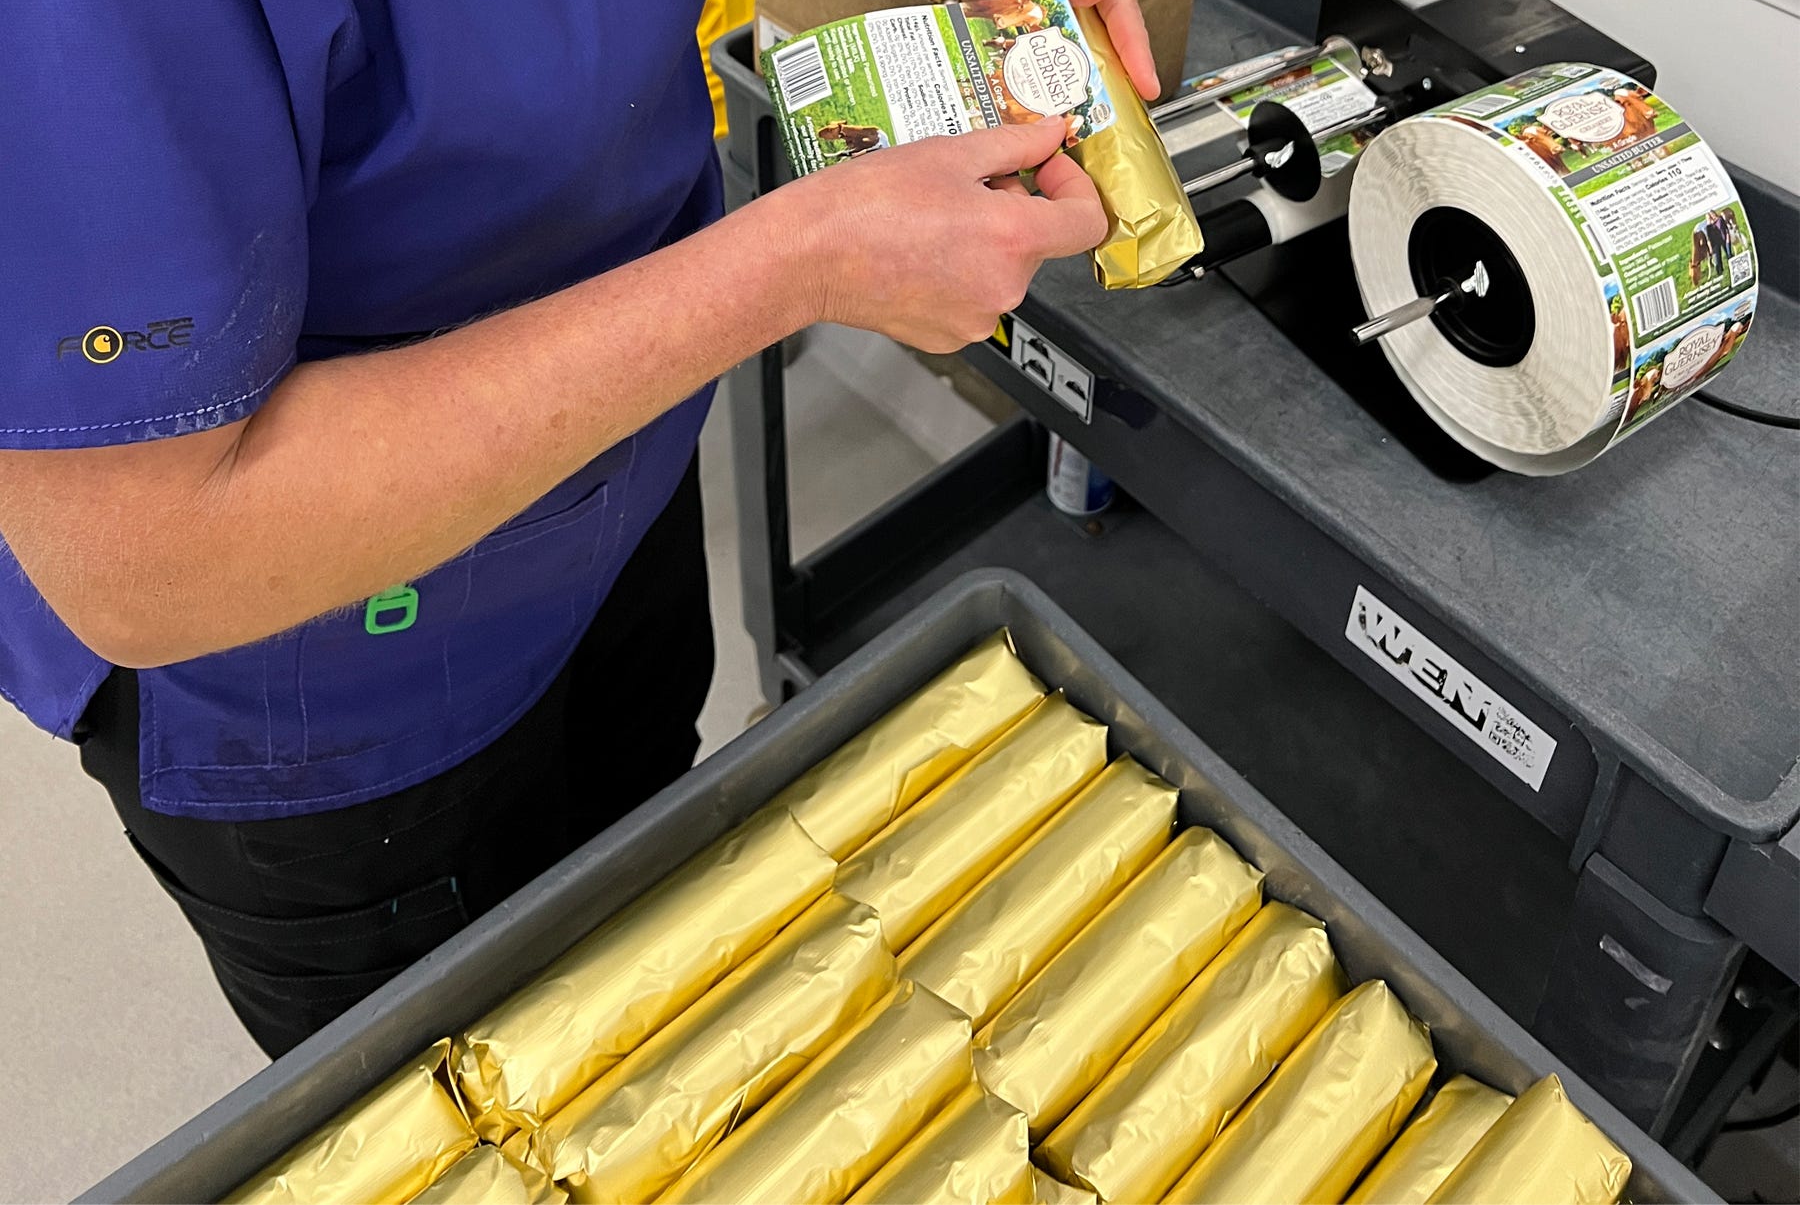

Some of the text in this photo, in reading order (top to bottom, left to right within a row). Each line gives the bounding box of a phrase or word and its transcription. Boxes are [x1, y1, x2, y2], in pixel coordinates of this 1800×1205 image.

[920, 14, 936, 46] Nutrition
[931, 46, 943, 67] Facts
[960, 39, 987, 95] UNSALTED
[979, 92, 998, 128] BUTTE
[1018, 56, 1041, 100] CREAMERY
[1027, 33, 1072, 109] GUERNSEY
[1049, 45, 1079, 91] ROYAL
[902, 86, 914, 109] Protein
[917, 83, 929, 107] Sodium
[933, 83, 949, 114] Calories
[944, 116, 957, 135] 110
[992, 84, 1007, 110] Grade
[1553, 97, 1591, 120] ROYAL
[1550, 97, 1612, 132] GUERNSEY
[1590, 148, 1633, 175] UNSALTED
[1630, 133, 1664, 156] BUTTER
[1589, 191, 1614, 207] Nutrition
[1614, 183, 1630, 195] Facts
[1644, 175, 1668, 190] Calories
[1667, 166, 1682, 179] 110
[1665, 334, 1720, 376] GUERNSEY
[1677, 332, 1710, 358] ROYAL
